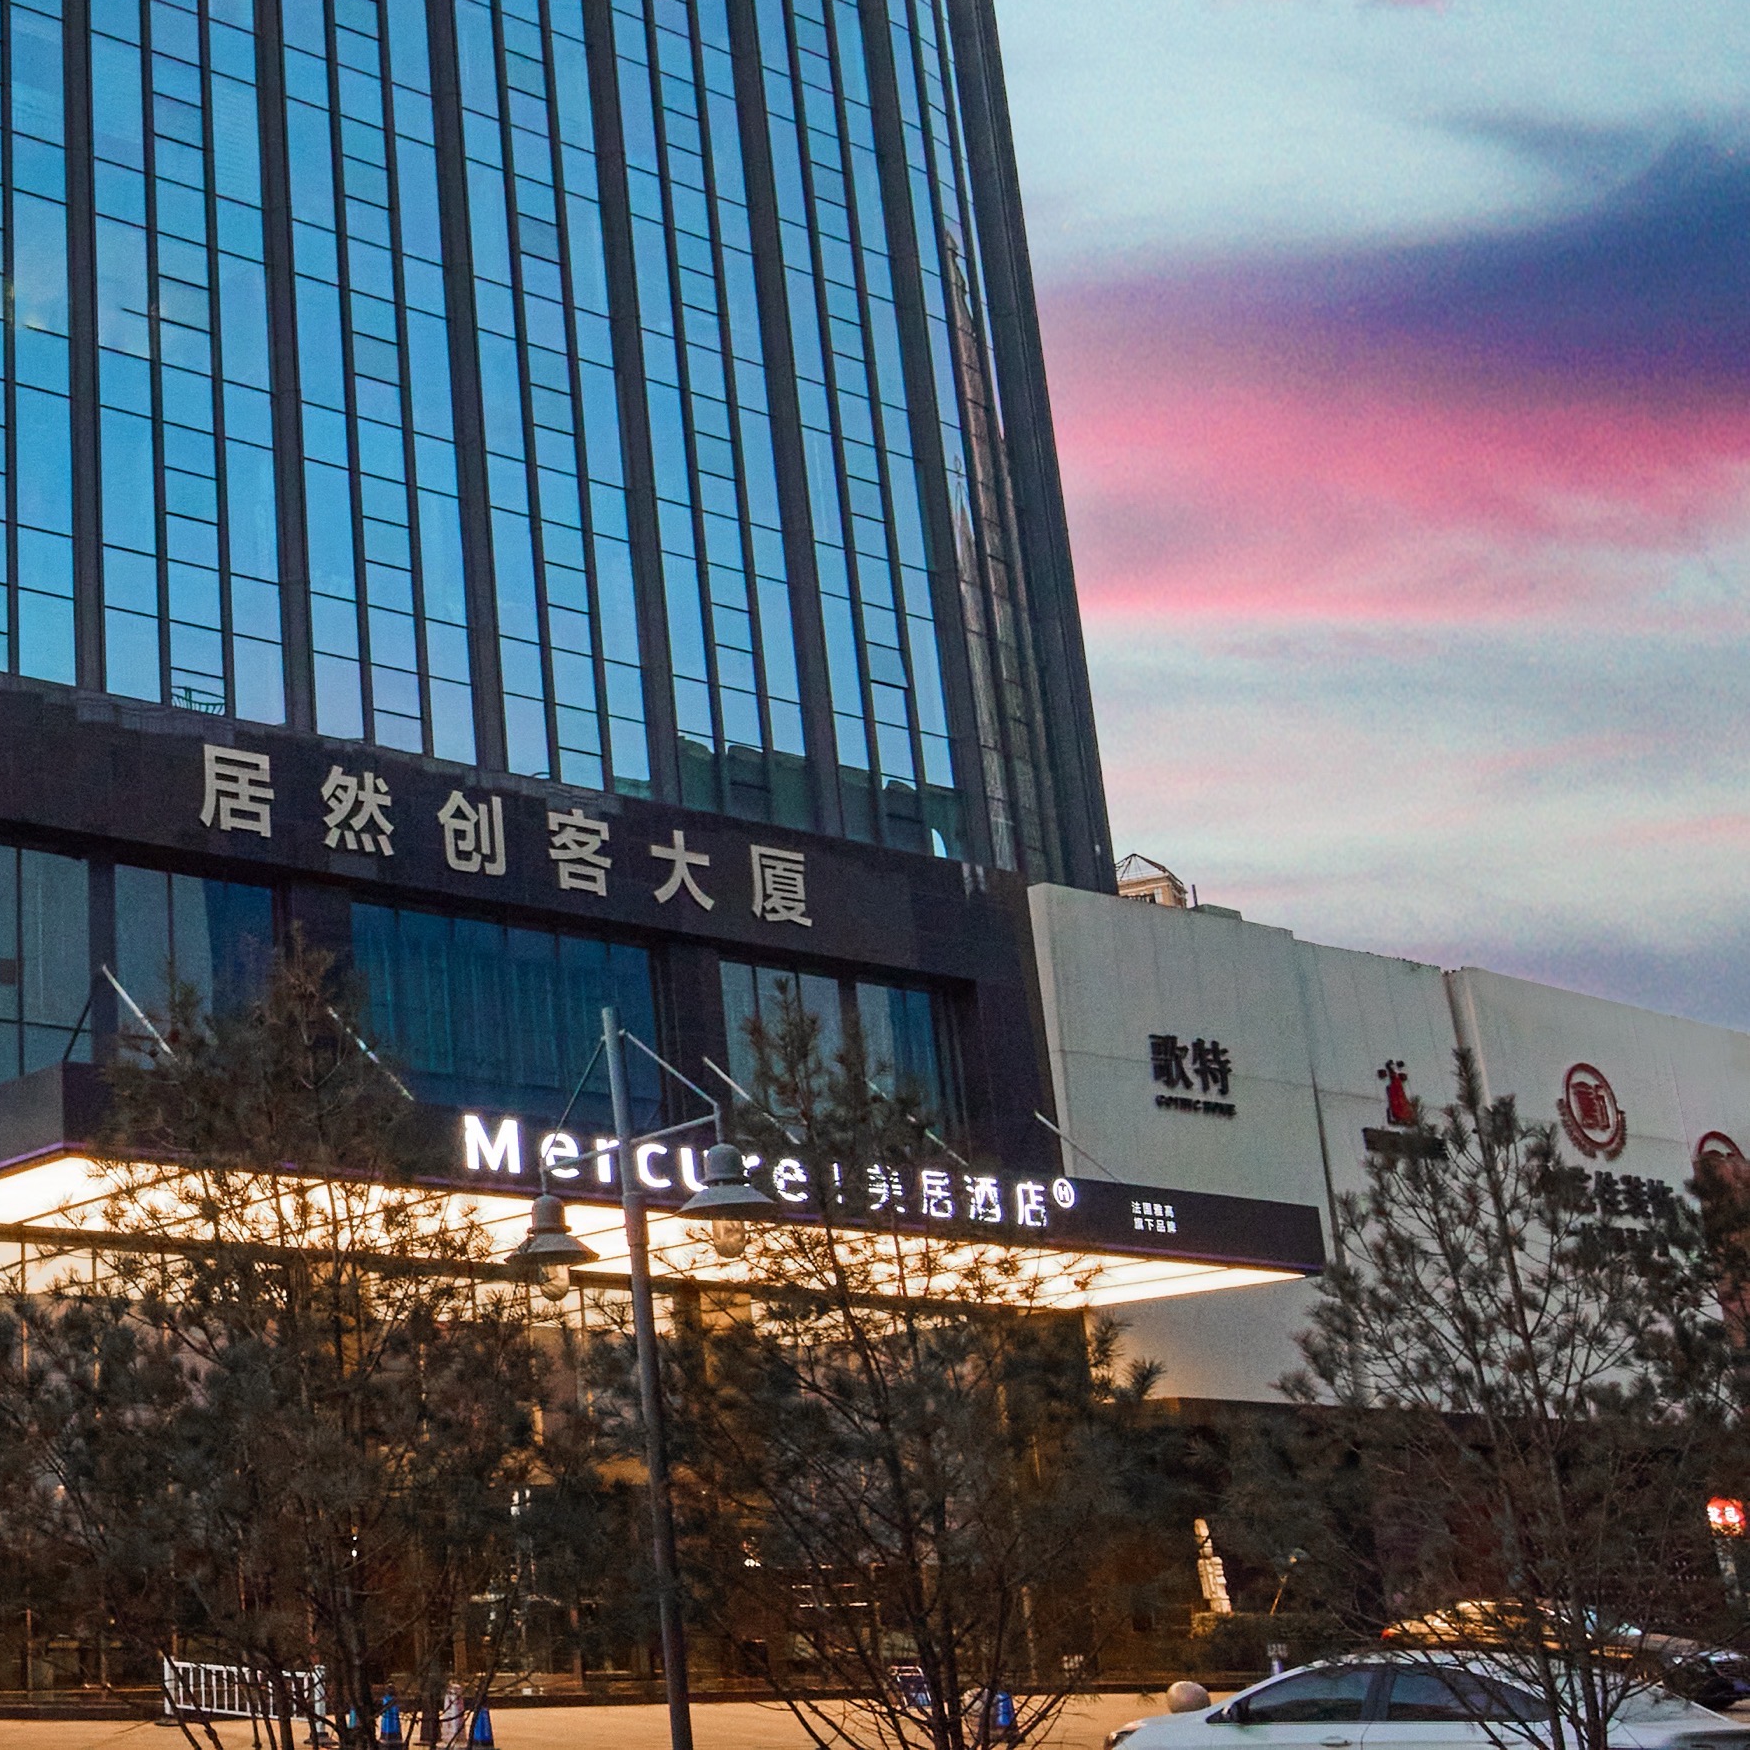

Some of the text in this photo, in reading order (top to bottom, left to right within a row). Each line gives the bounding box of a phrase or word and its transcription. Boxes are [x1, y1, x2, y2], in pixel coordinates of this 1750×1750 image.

[199, 743, 814, 928] 居然创客大厦
[1149, 1033, 1233, 1095] 歌特
[866, 1162, 1048, 1228] 美居酒店
